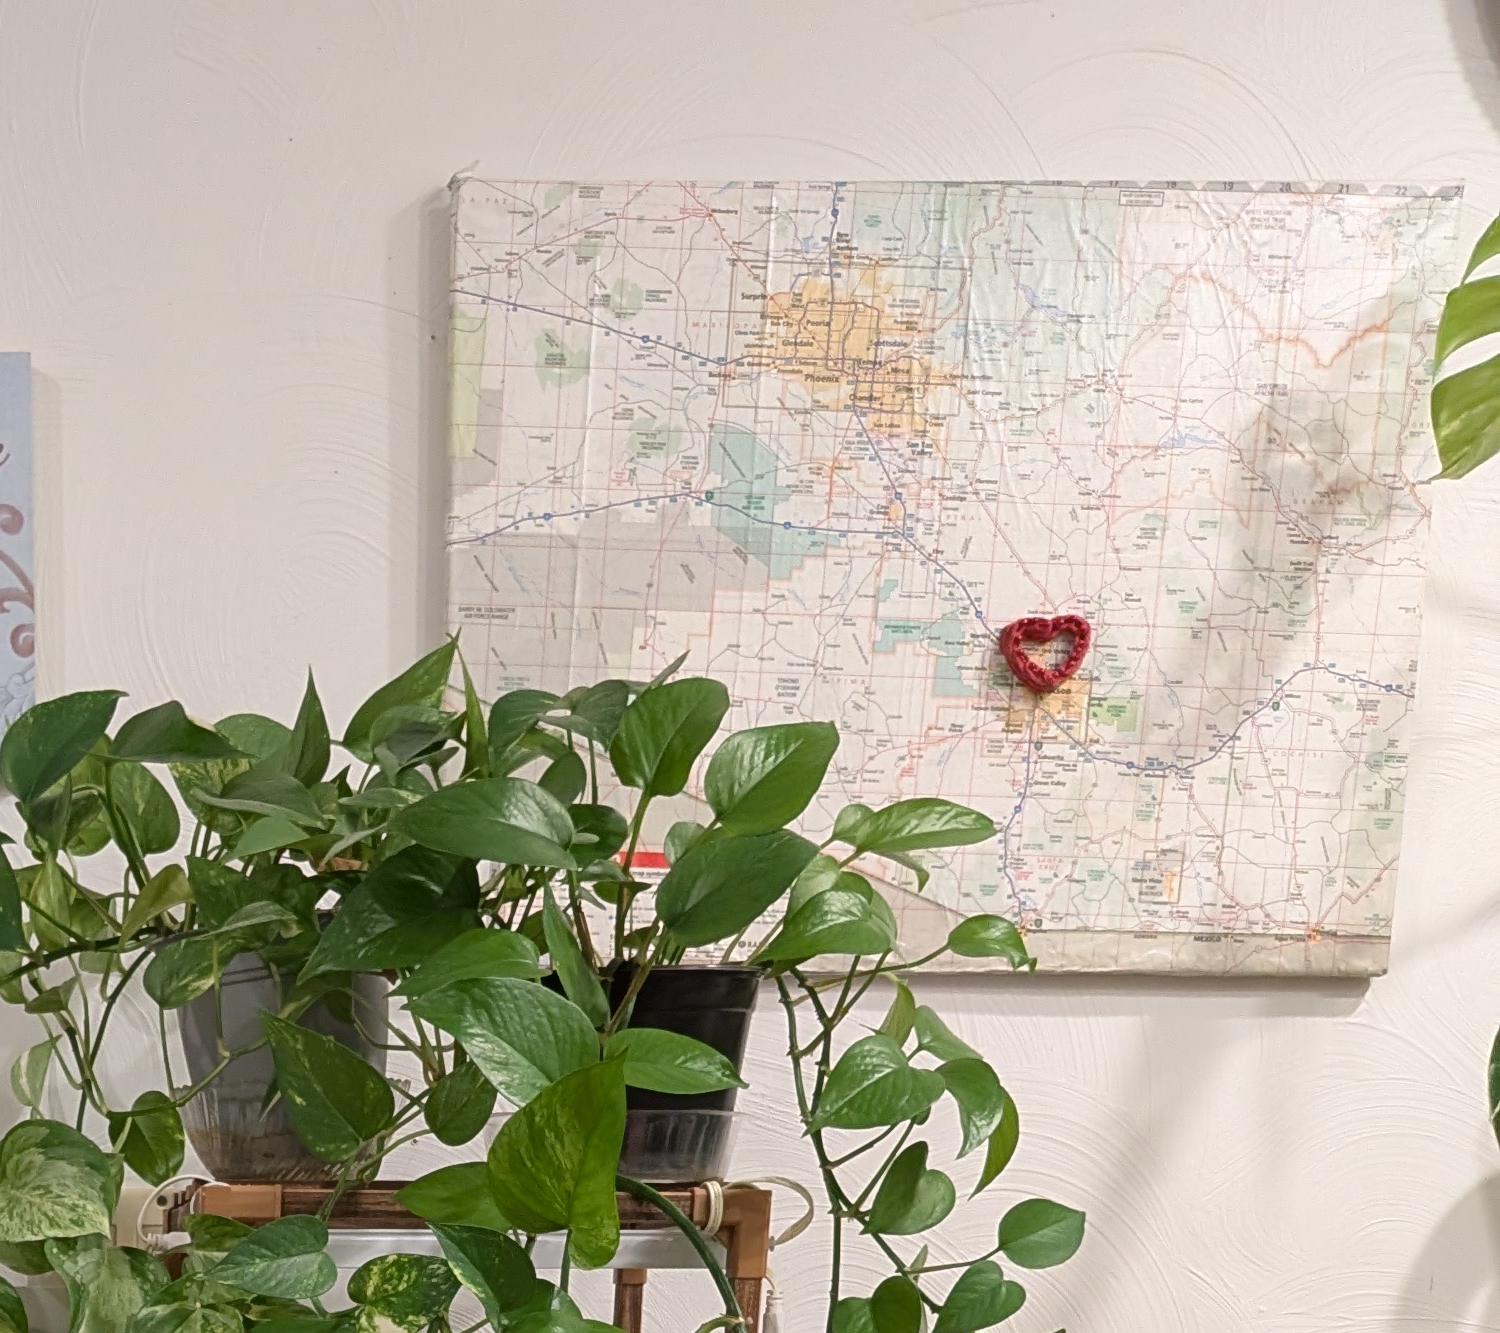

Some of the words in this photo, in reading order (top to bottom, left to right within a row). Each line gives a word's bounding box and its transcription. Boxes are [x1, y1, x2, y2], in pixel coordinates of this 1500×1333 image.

[1338, 184, 1350, 193] 21
[1395, 186, 1407, 195] 22
[805, 374, 839, 383] Phoenix
